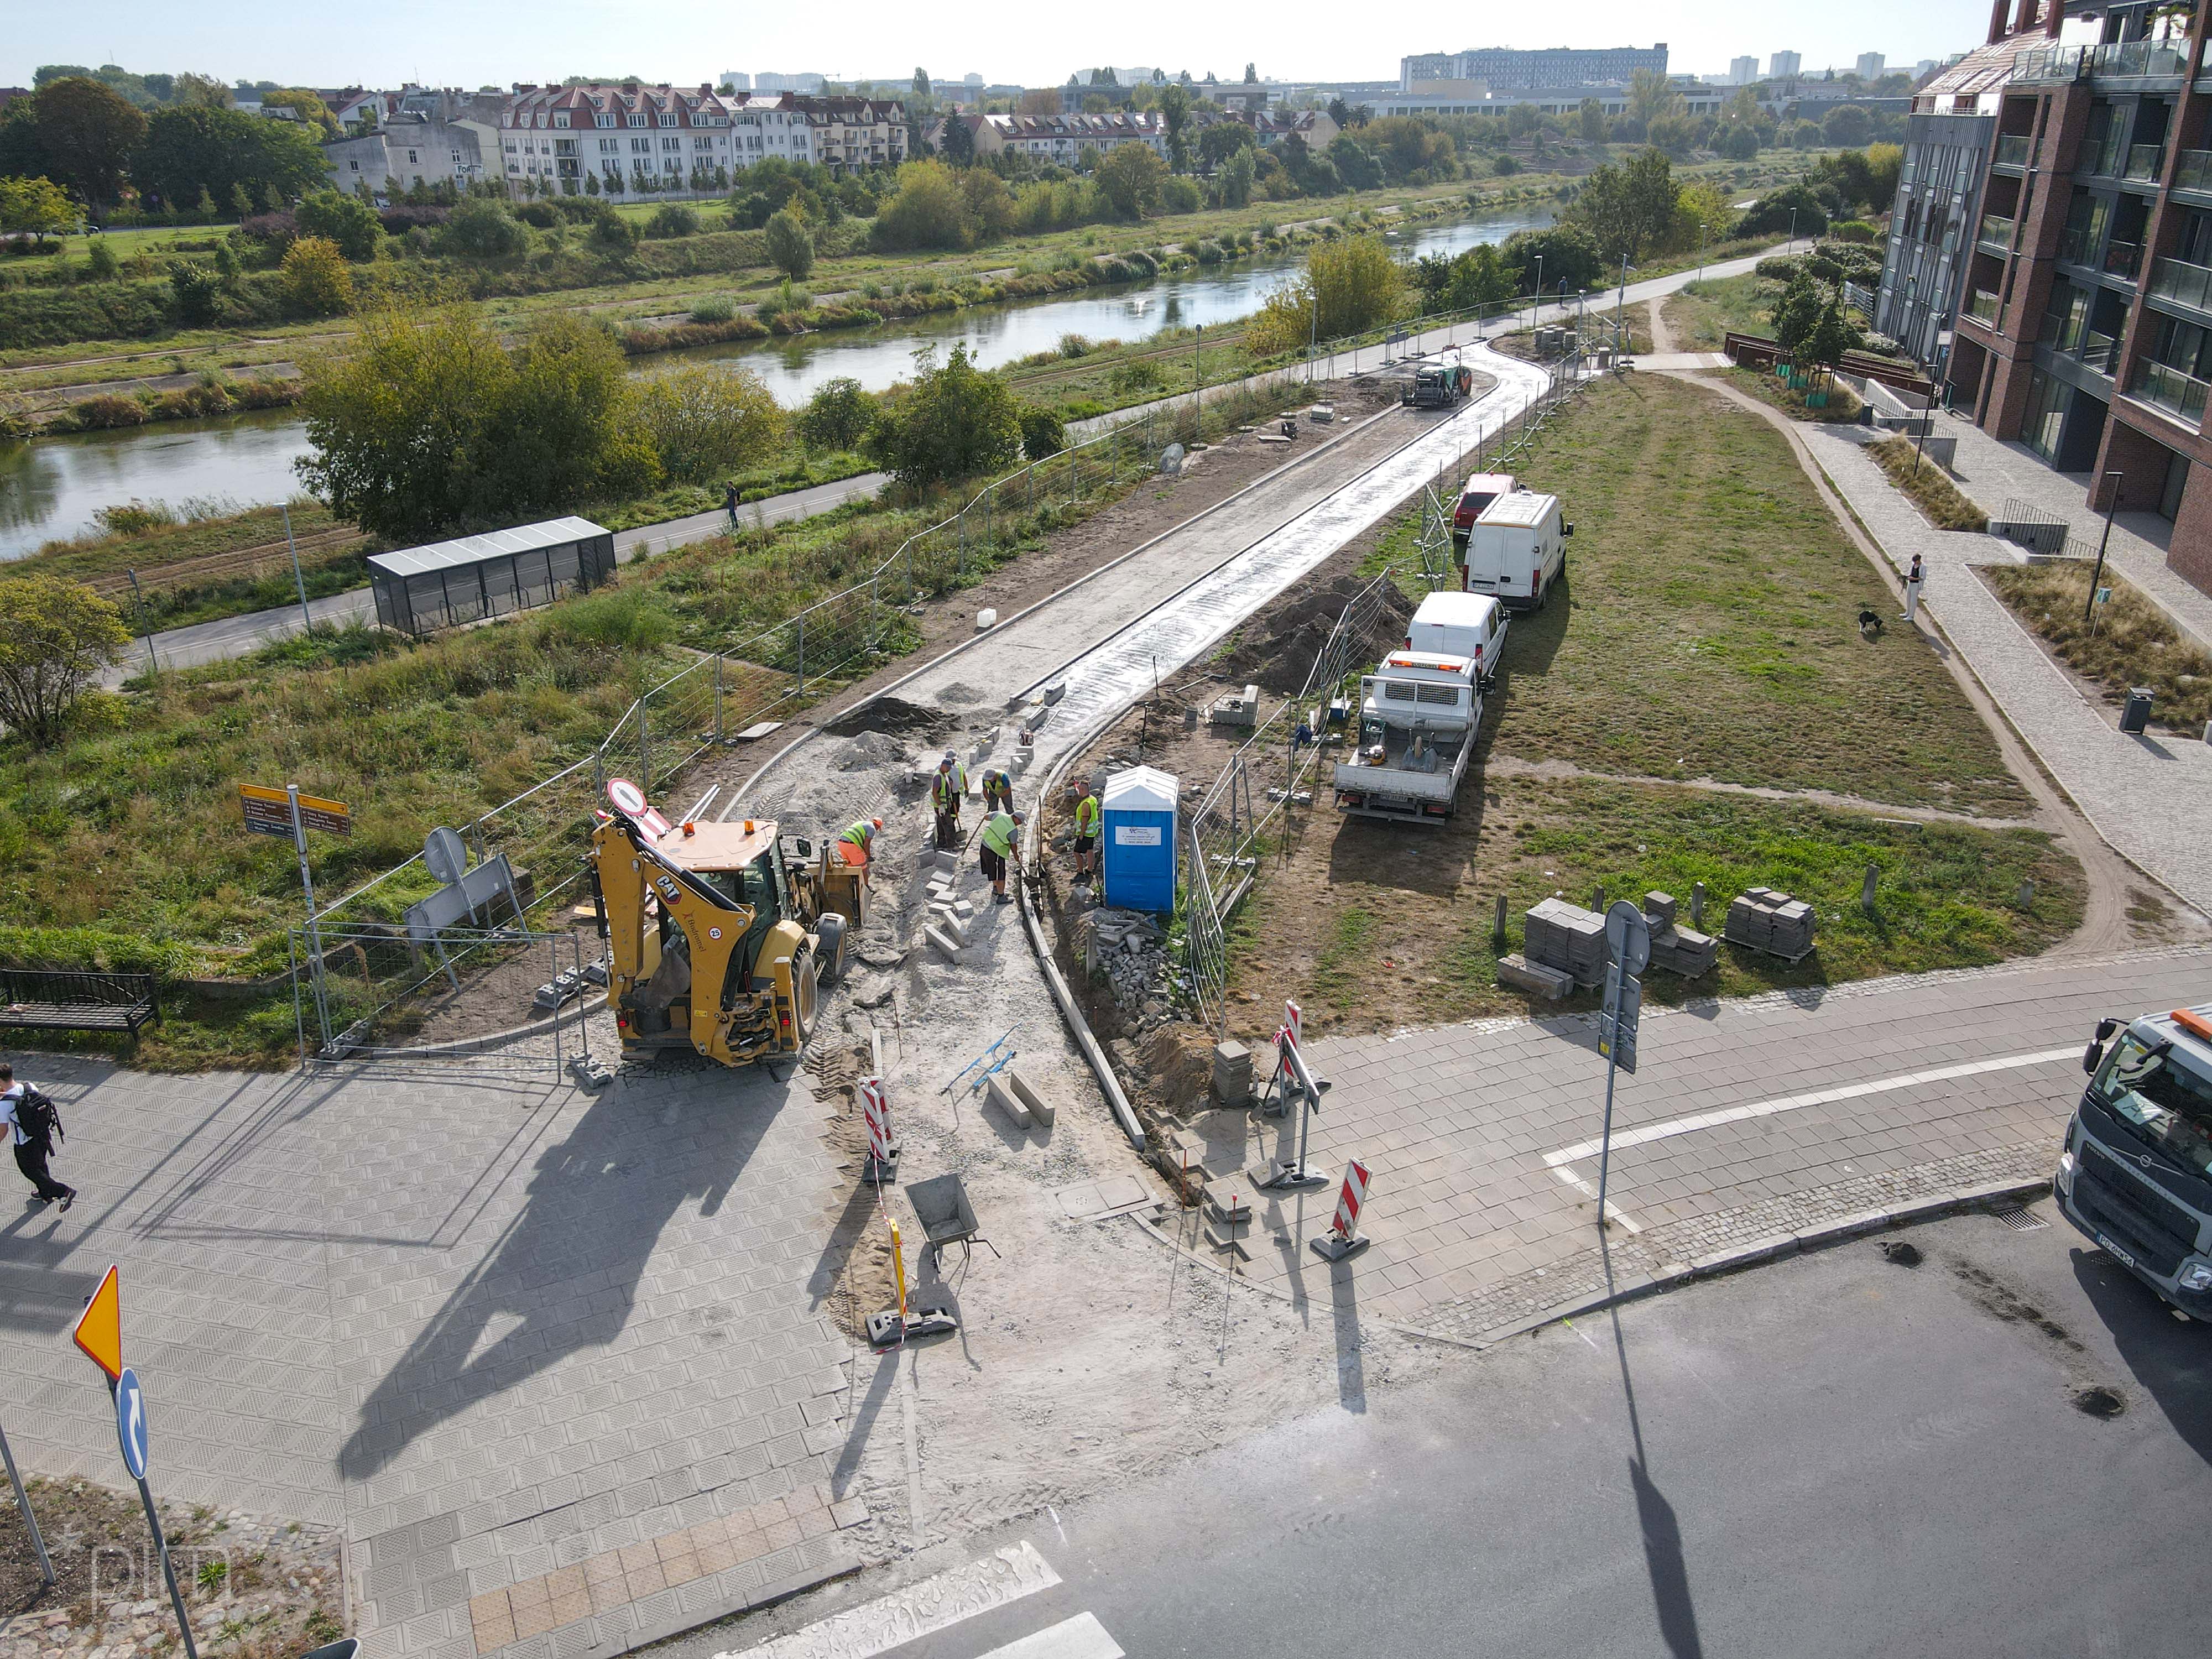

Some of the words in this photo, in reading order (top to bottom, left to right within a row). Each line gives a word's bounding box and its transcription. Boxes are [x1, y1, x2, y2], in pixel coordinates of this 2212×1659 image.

[656, 875, 680, 899] CAT
[688, 919, 707, 952] Budromel
[2086, 1142, 2106, 1160] VOLVO
[2100, 1236, 2110, 1248] PO
